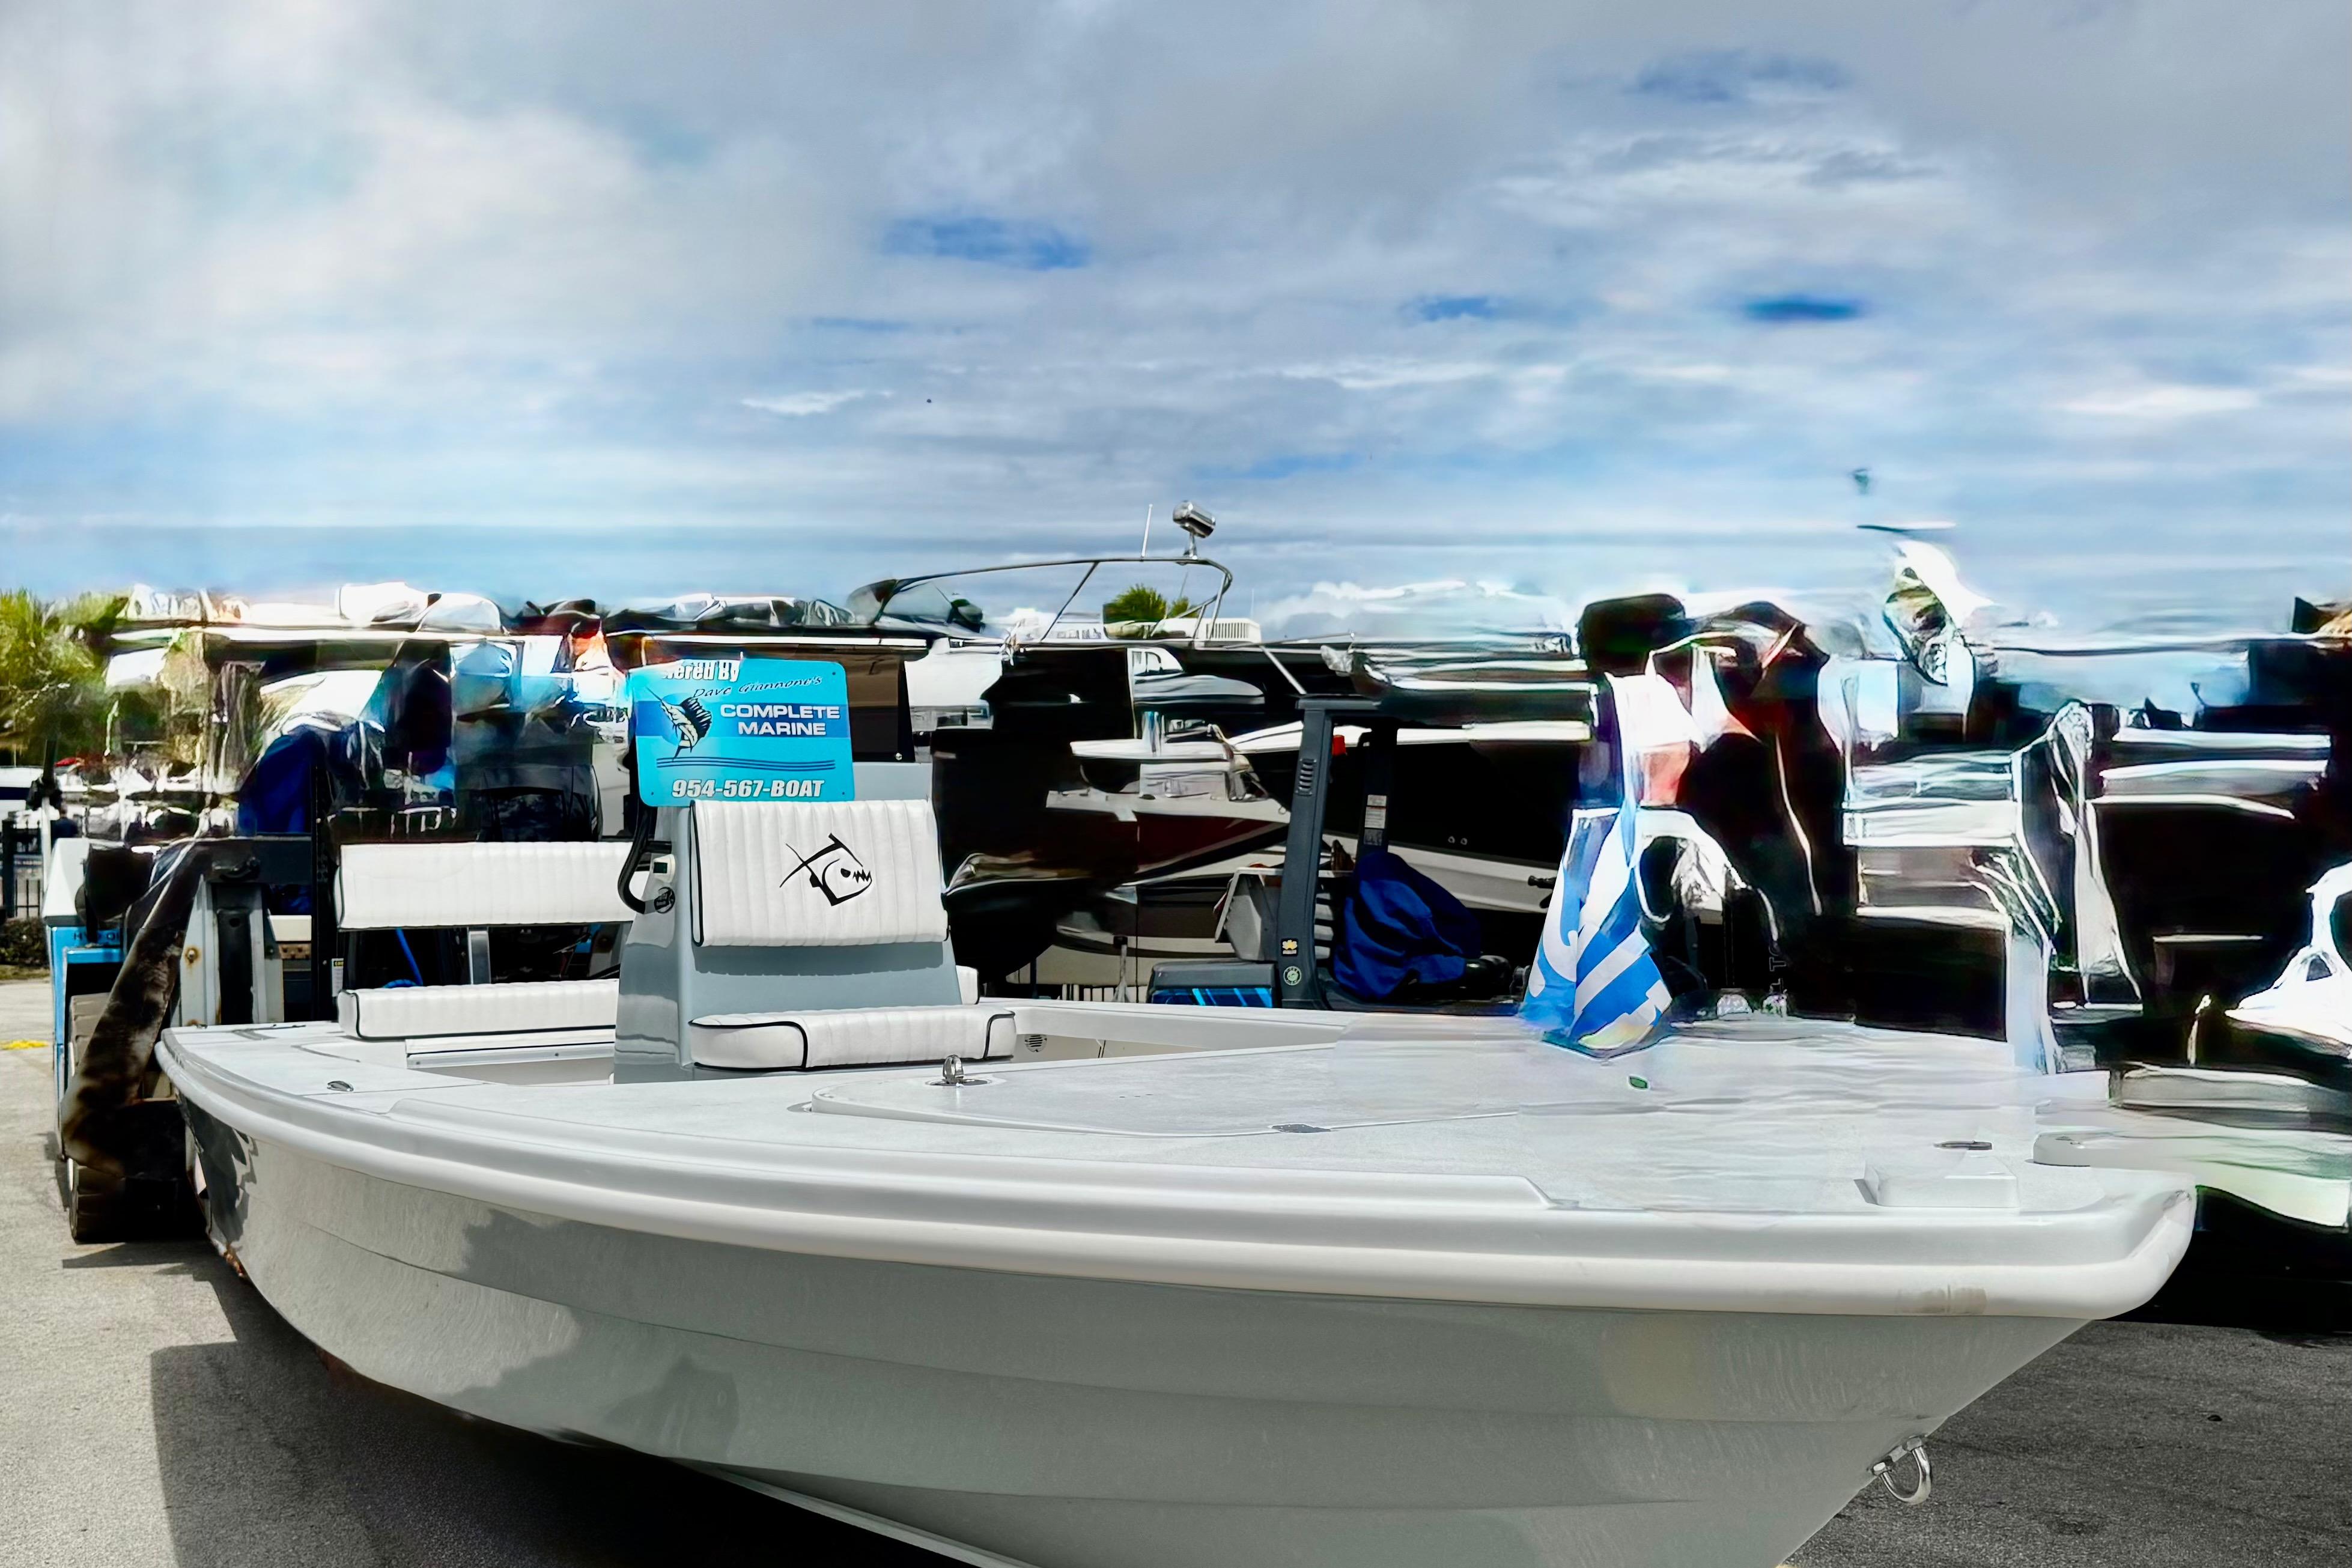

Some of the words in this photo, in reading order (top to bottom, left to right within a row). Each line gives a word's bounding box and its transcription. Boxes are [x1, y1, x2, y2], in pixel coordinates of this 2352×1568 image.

[717, 660, 740, 682] By
[693, 687, 732, 697] Dave
[720, 704, 840, 719] COMPLETE
[738, 722, 826, 736] MARINE
[672, 779, 825, 798] 954-567-BOAT
